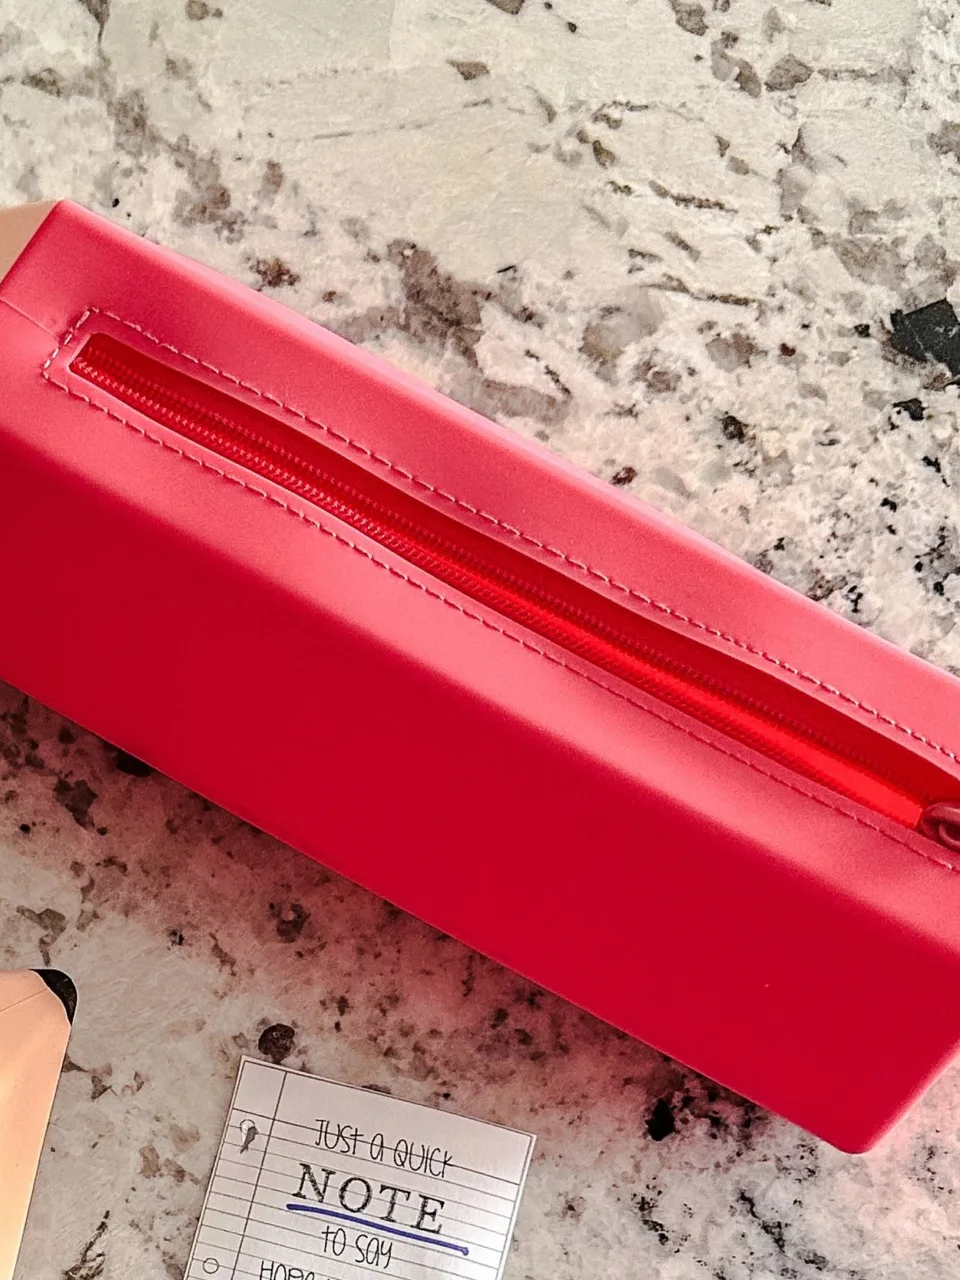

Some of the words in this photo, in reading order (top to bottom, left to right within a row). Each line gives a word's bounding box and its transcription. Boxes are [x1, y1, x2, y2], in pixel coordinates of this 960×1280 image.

[315, 1119, 364, 1155] JUST
[393, 1139, 453, 1178] QUICK
[292, 1162, 445, 1234] NOTE
